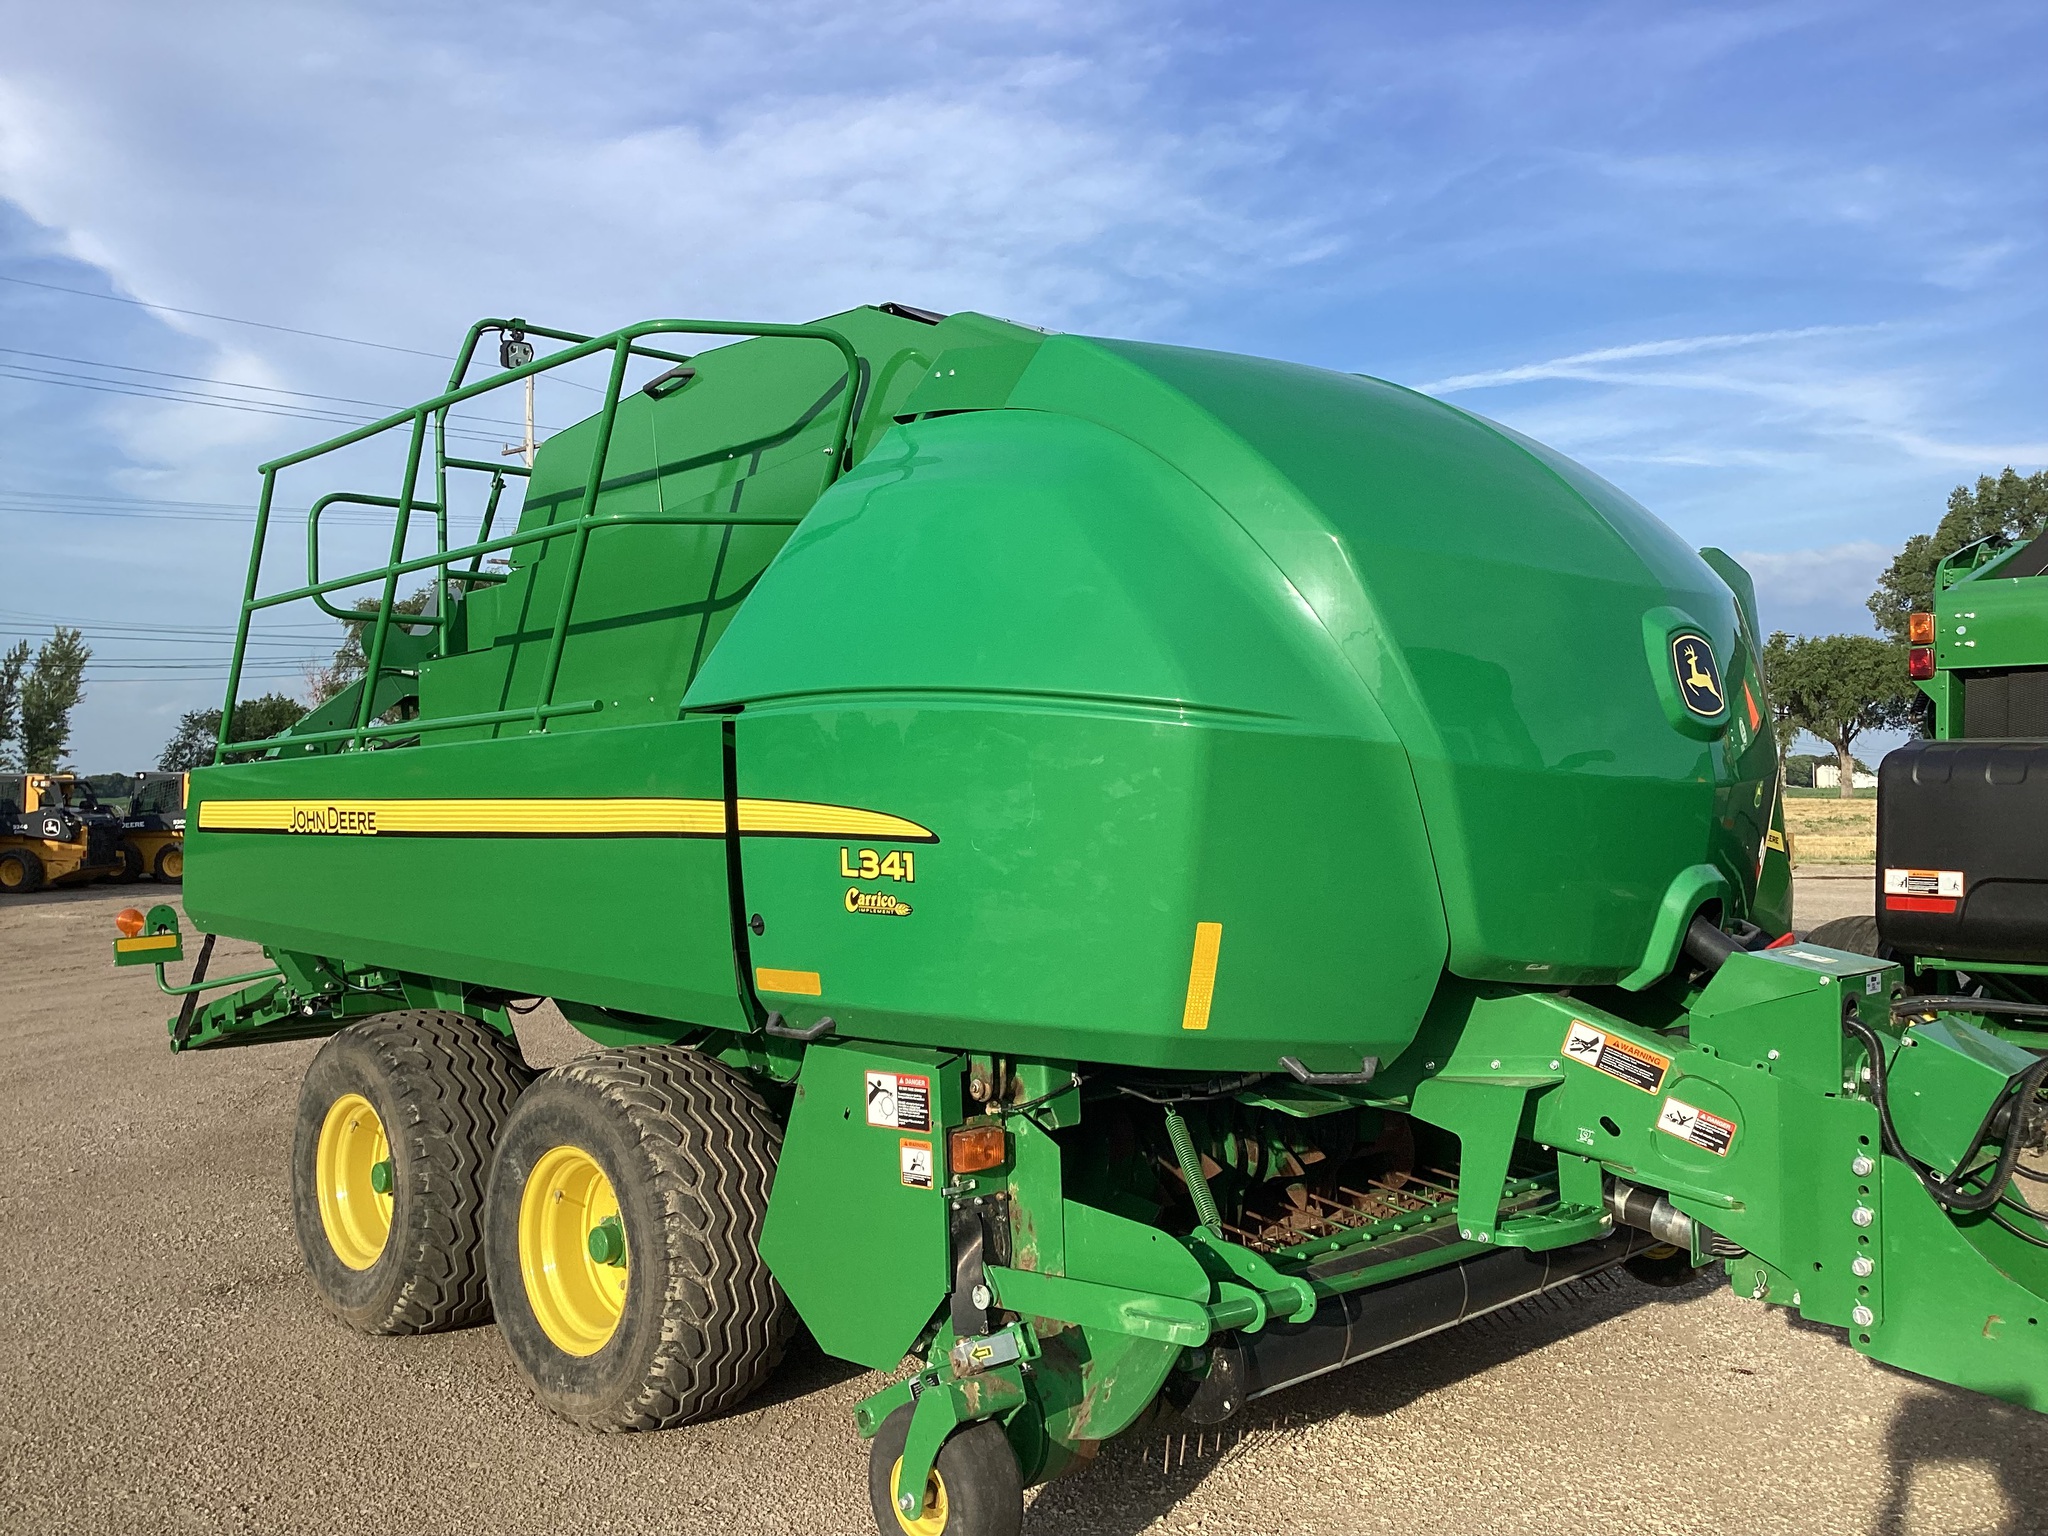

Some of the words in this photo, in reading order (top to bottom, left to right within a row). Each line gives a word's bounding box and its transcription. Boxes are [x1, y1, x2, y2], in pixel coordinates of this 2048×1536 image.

[289, 806, 326, 831] JOHN
[327, 806, 377, 832] DEERE
[840, 846, 916, 883] L341
[845, 887, 897, 913] Carrico
[1619, 1042, 1662, 1067] WARNING
[904, 1078, 926, 1087] DANGER
[1706, 1115, 1733, 1132] DANGER
